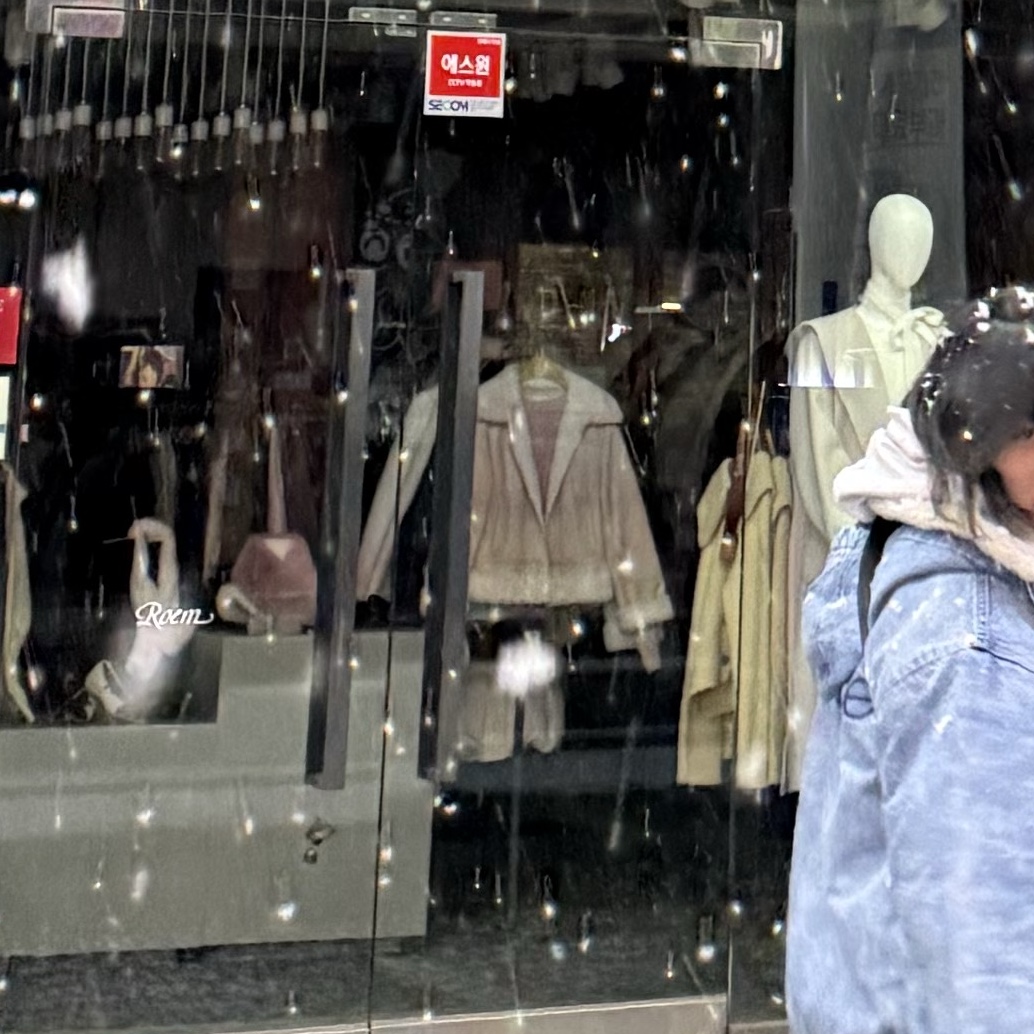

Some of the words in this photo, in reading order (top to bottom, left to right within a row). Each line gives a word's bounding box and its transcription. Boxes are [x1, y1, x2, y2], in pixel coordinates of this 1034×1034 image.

[441, 54, 490, 76] 에스원
[428, 100, 469, 112] SECOM
[135, 601, 214, 630] Roem
